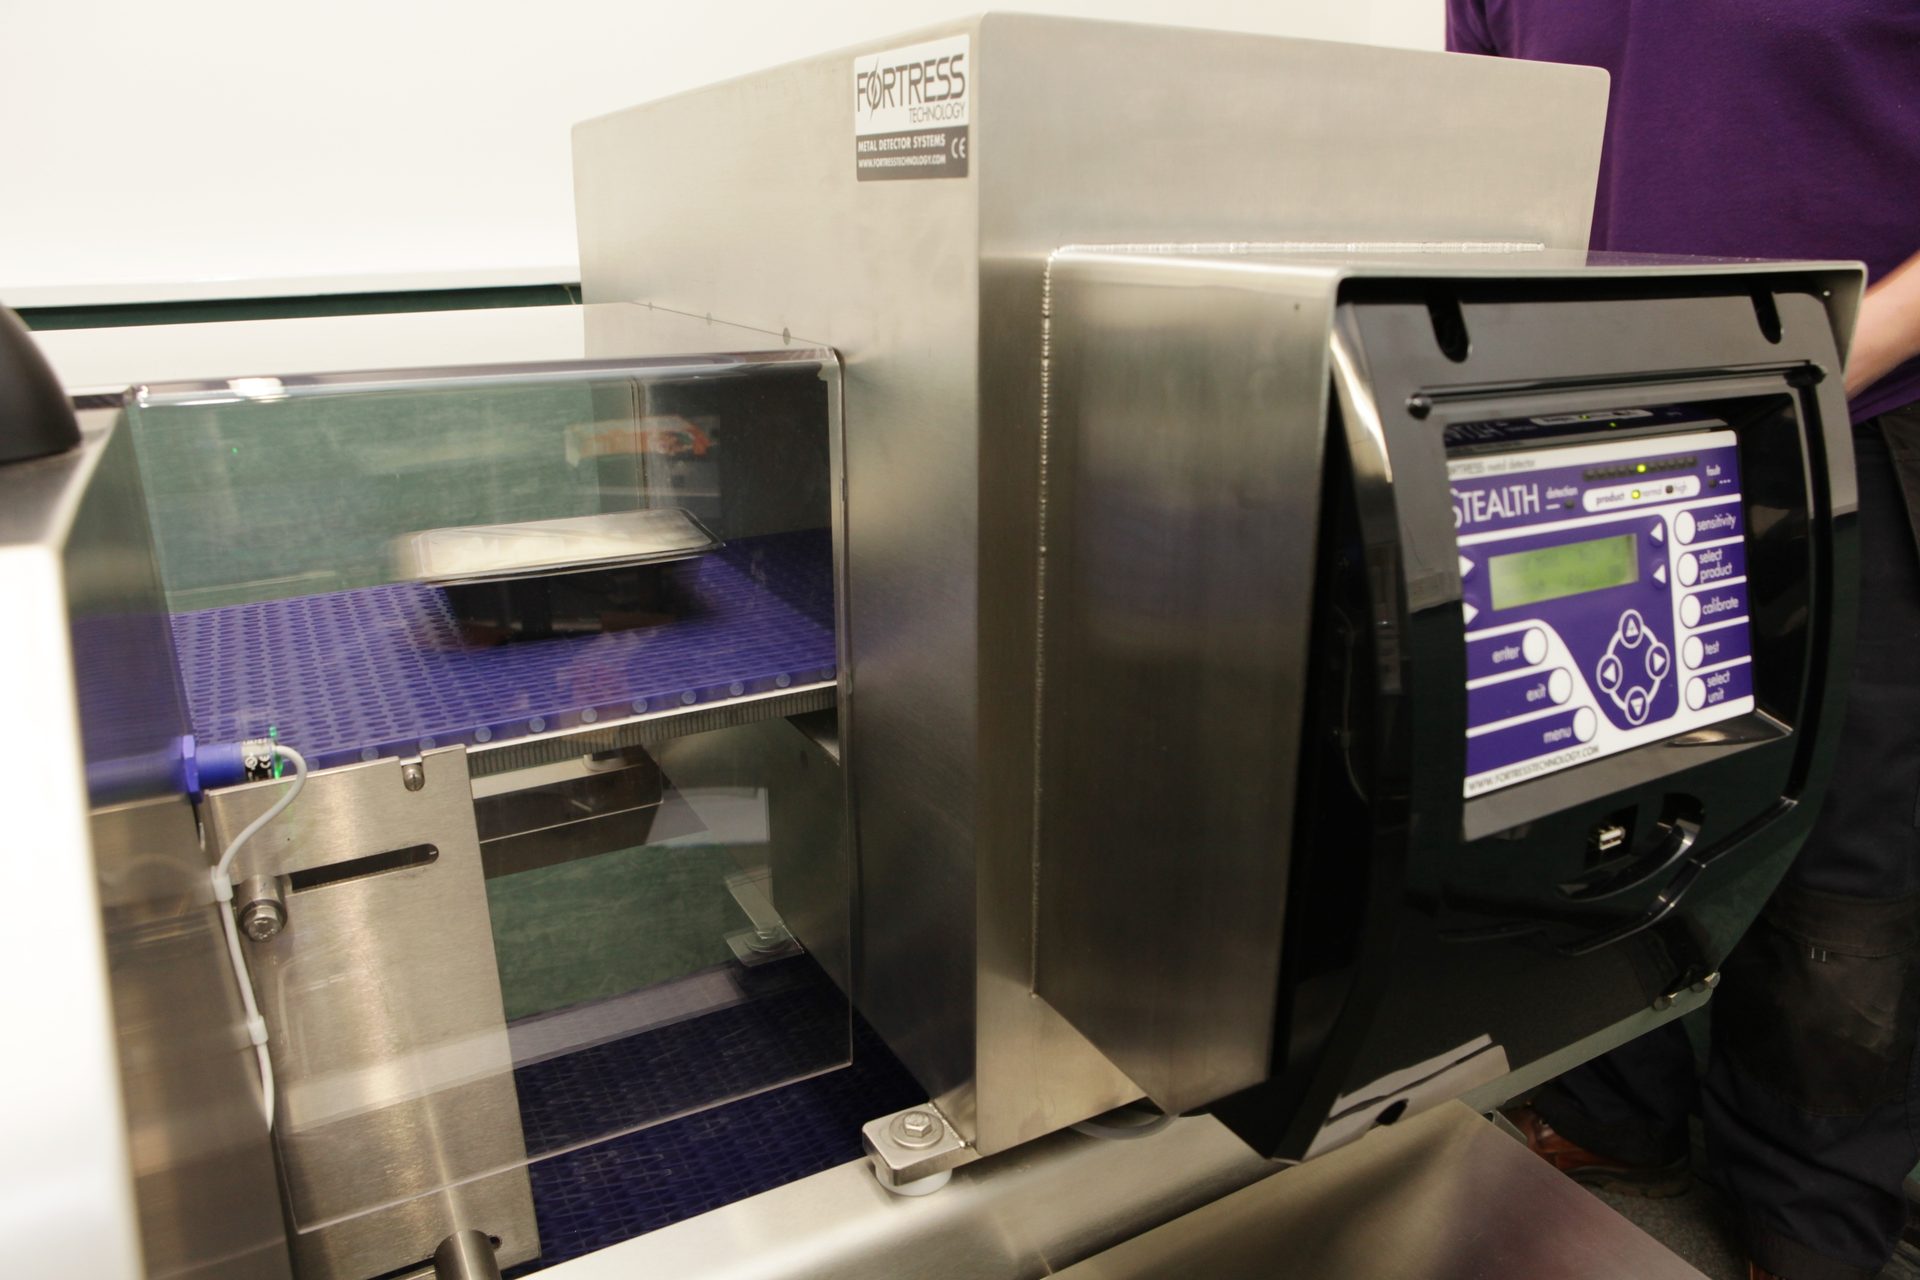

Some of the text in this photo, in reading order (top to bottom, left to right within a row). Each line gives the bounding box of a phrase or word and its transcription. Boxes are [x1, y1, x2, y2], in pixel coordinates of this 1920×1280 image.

[857, 53, 966, 113] FORTRESS
[909, 102, 965, 123] TECHNOLOGY
[858, 133, 946, 152] METAL DETECTOR SYSTEMS
[951, 137, 966, 159] CE
[1596, 490, 1624, 506] product
[1697, 512, 1736, 531] sensitivity
[1699, 548, 1722, 564] select
[1700, 562, 1732, 584] product
[1702, 596, 1739, 615] calibrate
[1491, 646, 1520, 663] enter
[1704, 640, 1720, 655] test
[1707, 670, 1730, 688] select
[1526, 683, 1546, 702] exit
[1708, 687, 1724, 703] unit
[1543, 727, 1572, 744] menu
